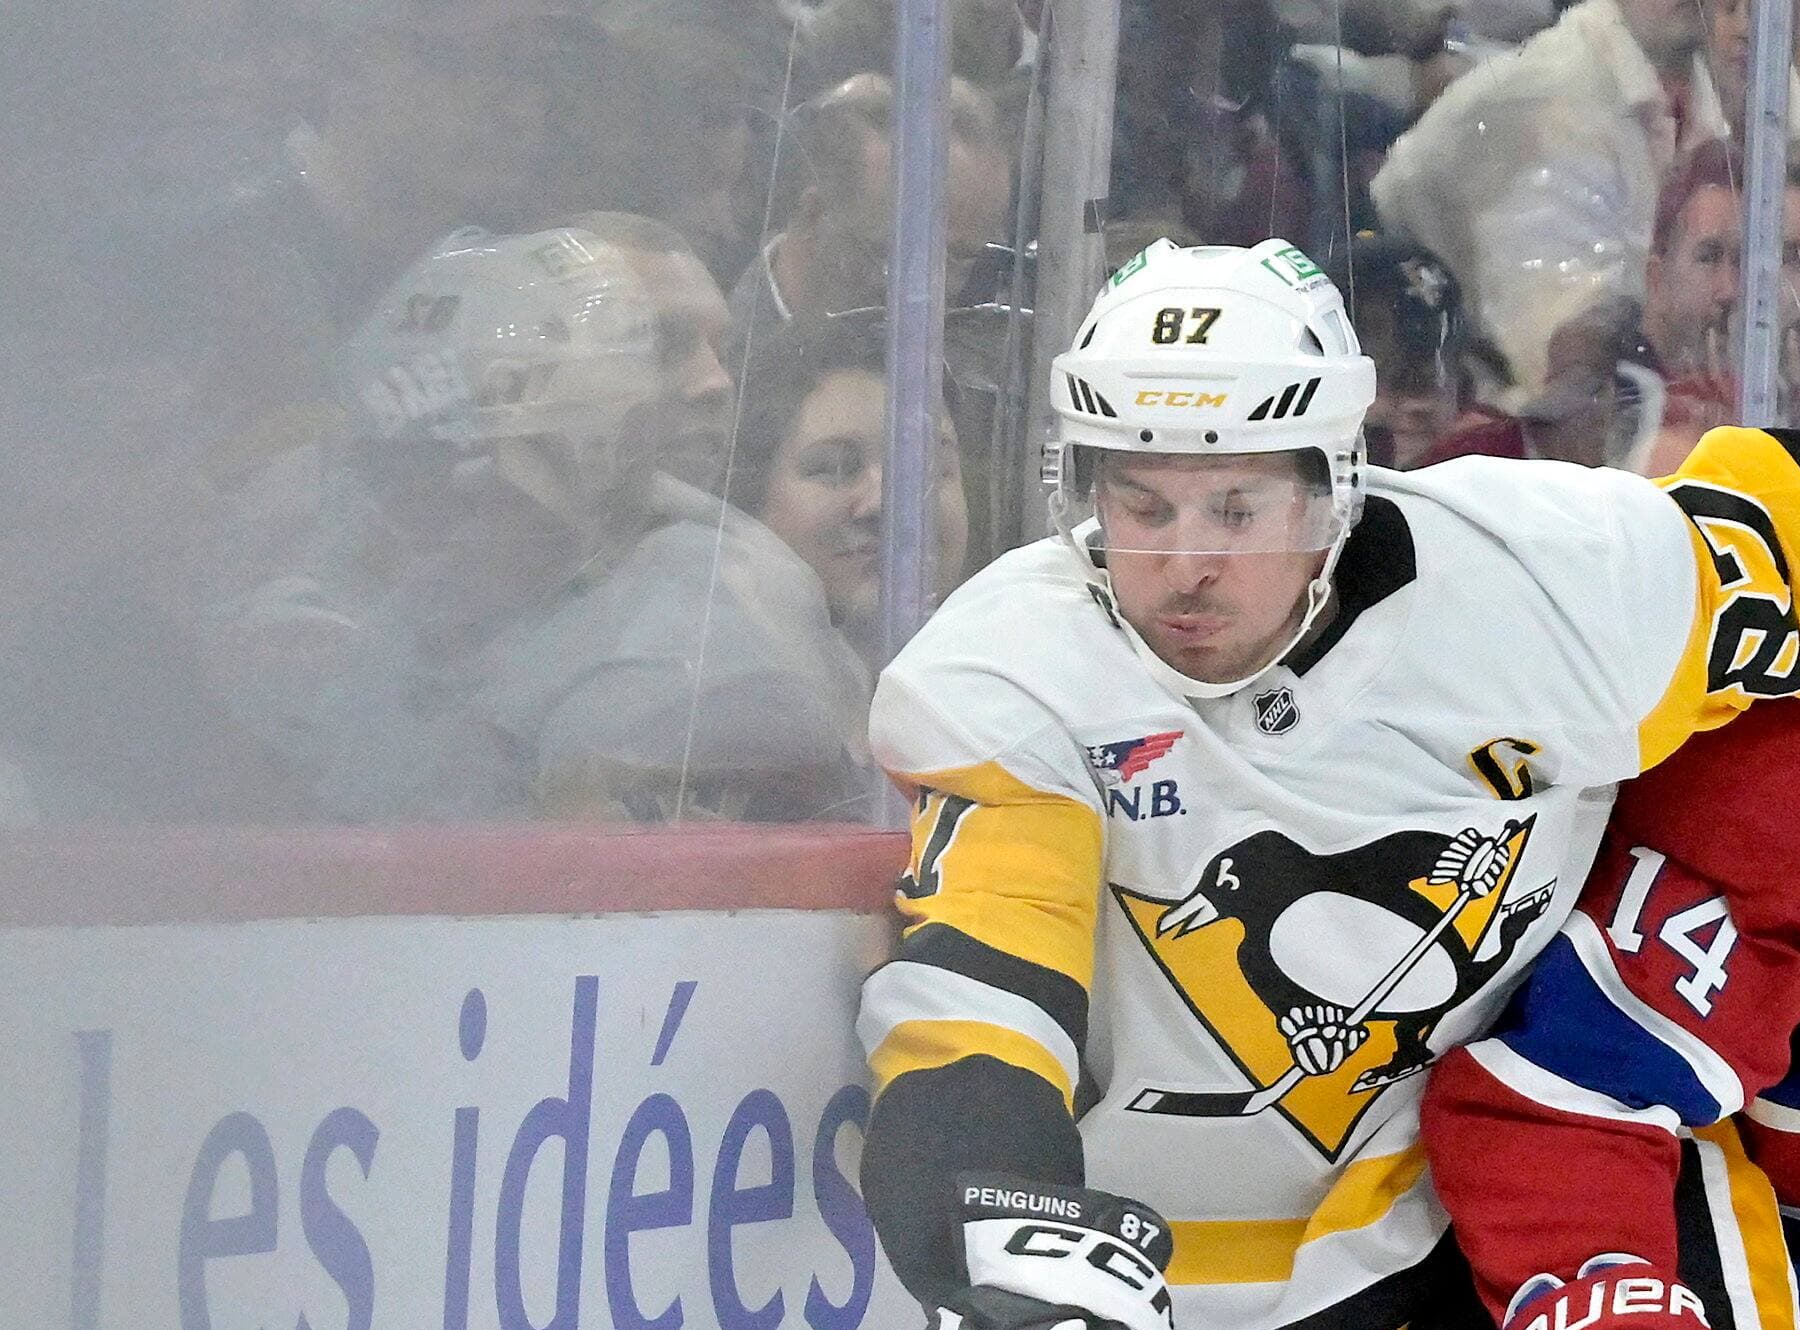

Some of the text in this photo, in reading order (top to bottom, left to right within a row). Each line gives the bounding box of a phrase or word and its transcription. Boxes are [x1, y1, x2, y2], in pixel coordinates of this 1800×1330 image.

[1151, 307, 1222, 345] 87
[1135, 390, 1228, 408] CCM
[1605, 845, 1742, 1018] 14
[964, 1187, 1082, 1219] PENGUINS
[1120, 1213, 1161, 1248] 87
